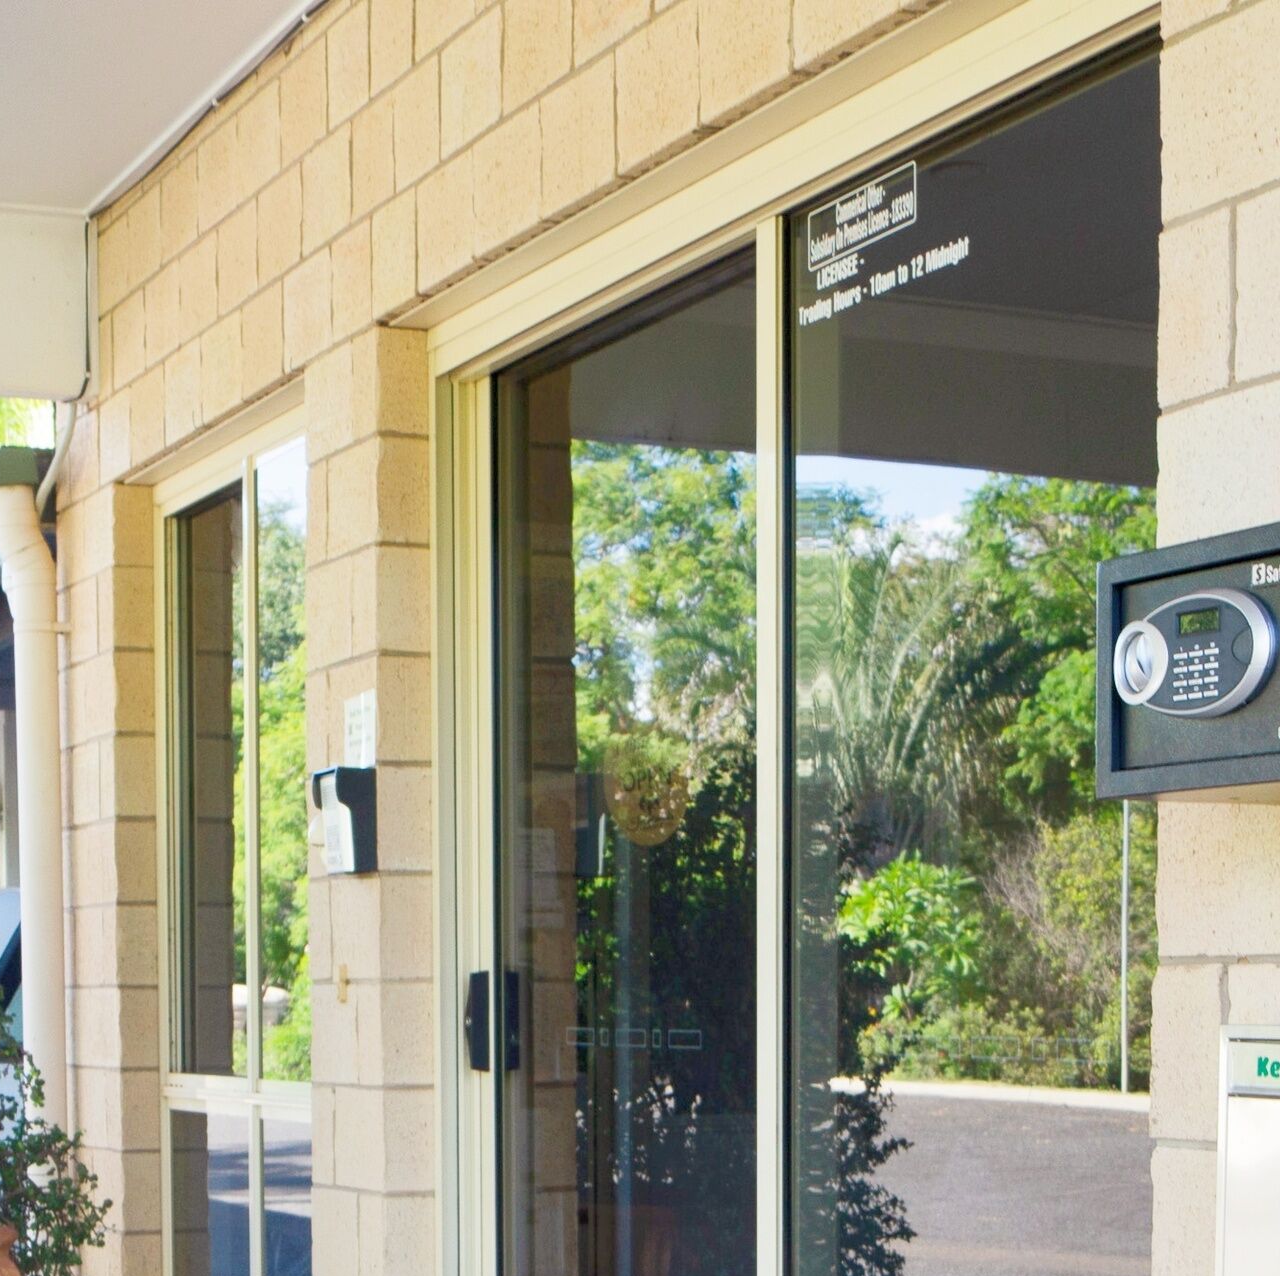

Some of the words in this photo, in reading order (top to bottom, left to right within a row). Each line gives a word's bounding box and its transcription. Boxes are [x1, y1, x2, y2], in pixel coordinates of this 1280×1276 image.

[798, 297, 832, 326] Trading
[833, 285, 862, 313] Hours
[869, 270, 896, 297] 10am
[897, 264, 908, 285] to
[910, 254, 923, 279] 12
[925, 236, 969, 273] Midnight
[816, 252, 858, 291] LICENSEE
